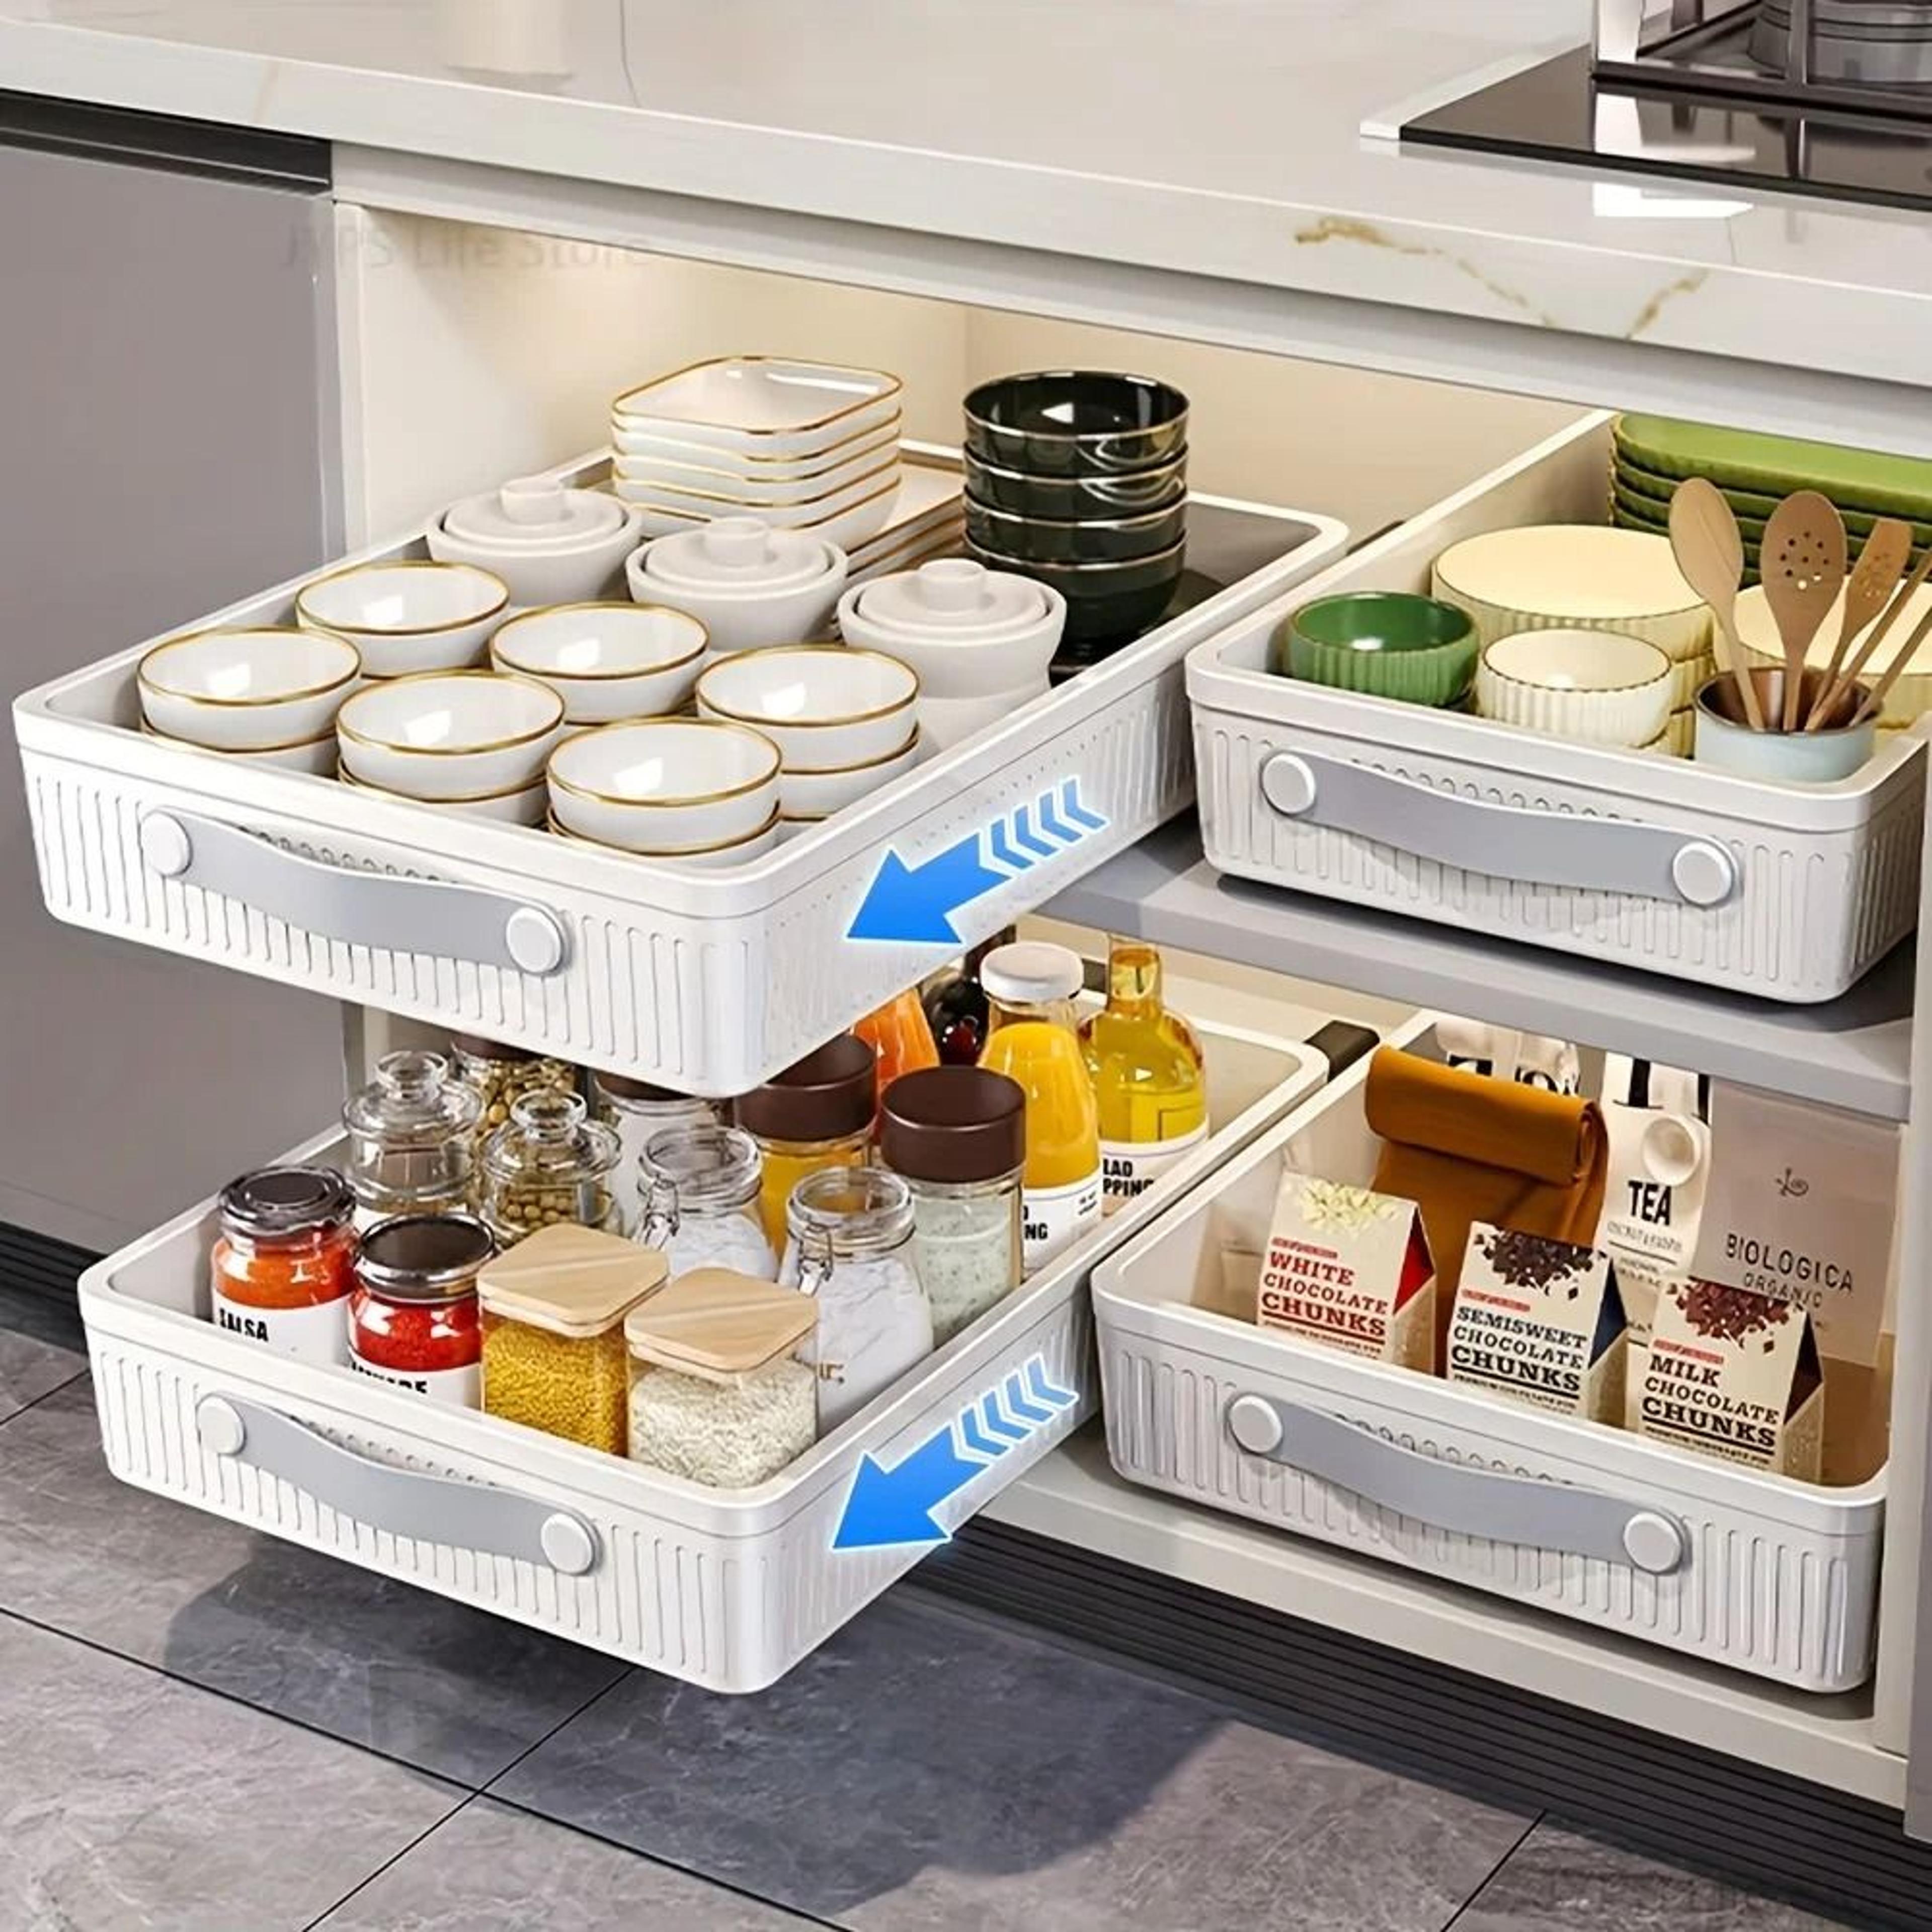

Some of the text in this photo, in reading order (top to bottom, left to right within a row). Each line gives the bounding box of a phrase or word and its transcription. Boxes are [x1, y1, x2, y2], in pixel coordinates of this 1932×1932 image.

[1628, 1179, 1672, 1226] TEA
[1270, 1251, 1355, 1286] WHITE
[1726, 1233, 1853, 1293] BIOLOGICA
[1262, 1292, 1385, 1336] CHUNKS
[1264, 1273, 1388, 1315] CHOCOLATE
[1454, 1325, 1584, 1370] CHOCOLATE
[1457, 1306, 1587, 1349] SEMISWEET
[1452, 1345, 1580, 1391] CHUNKS
[1649, 1354, 1721, 1388] MILK
[1642, 1396, 1776, 1447] CHUNKS
[1645, 1377, 1780, 1424] CHOCOLATE
